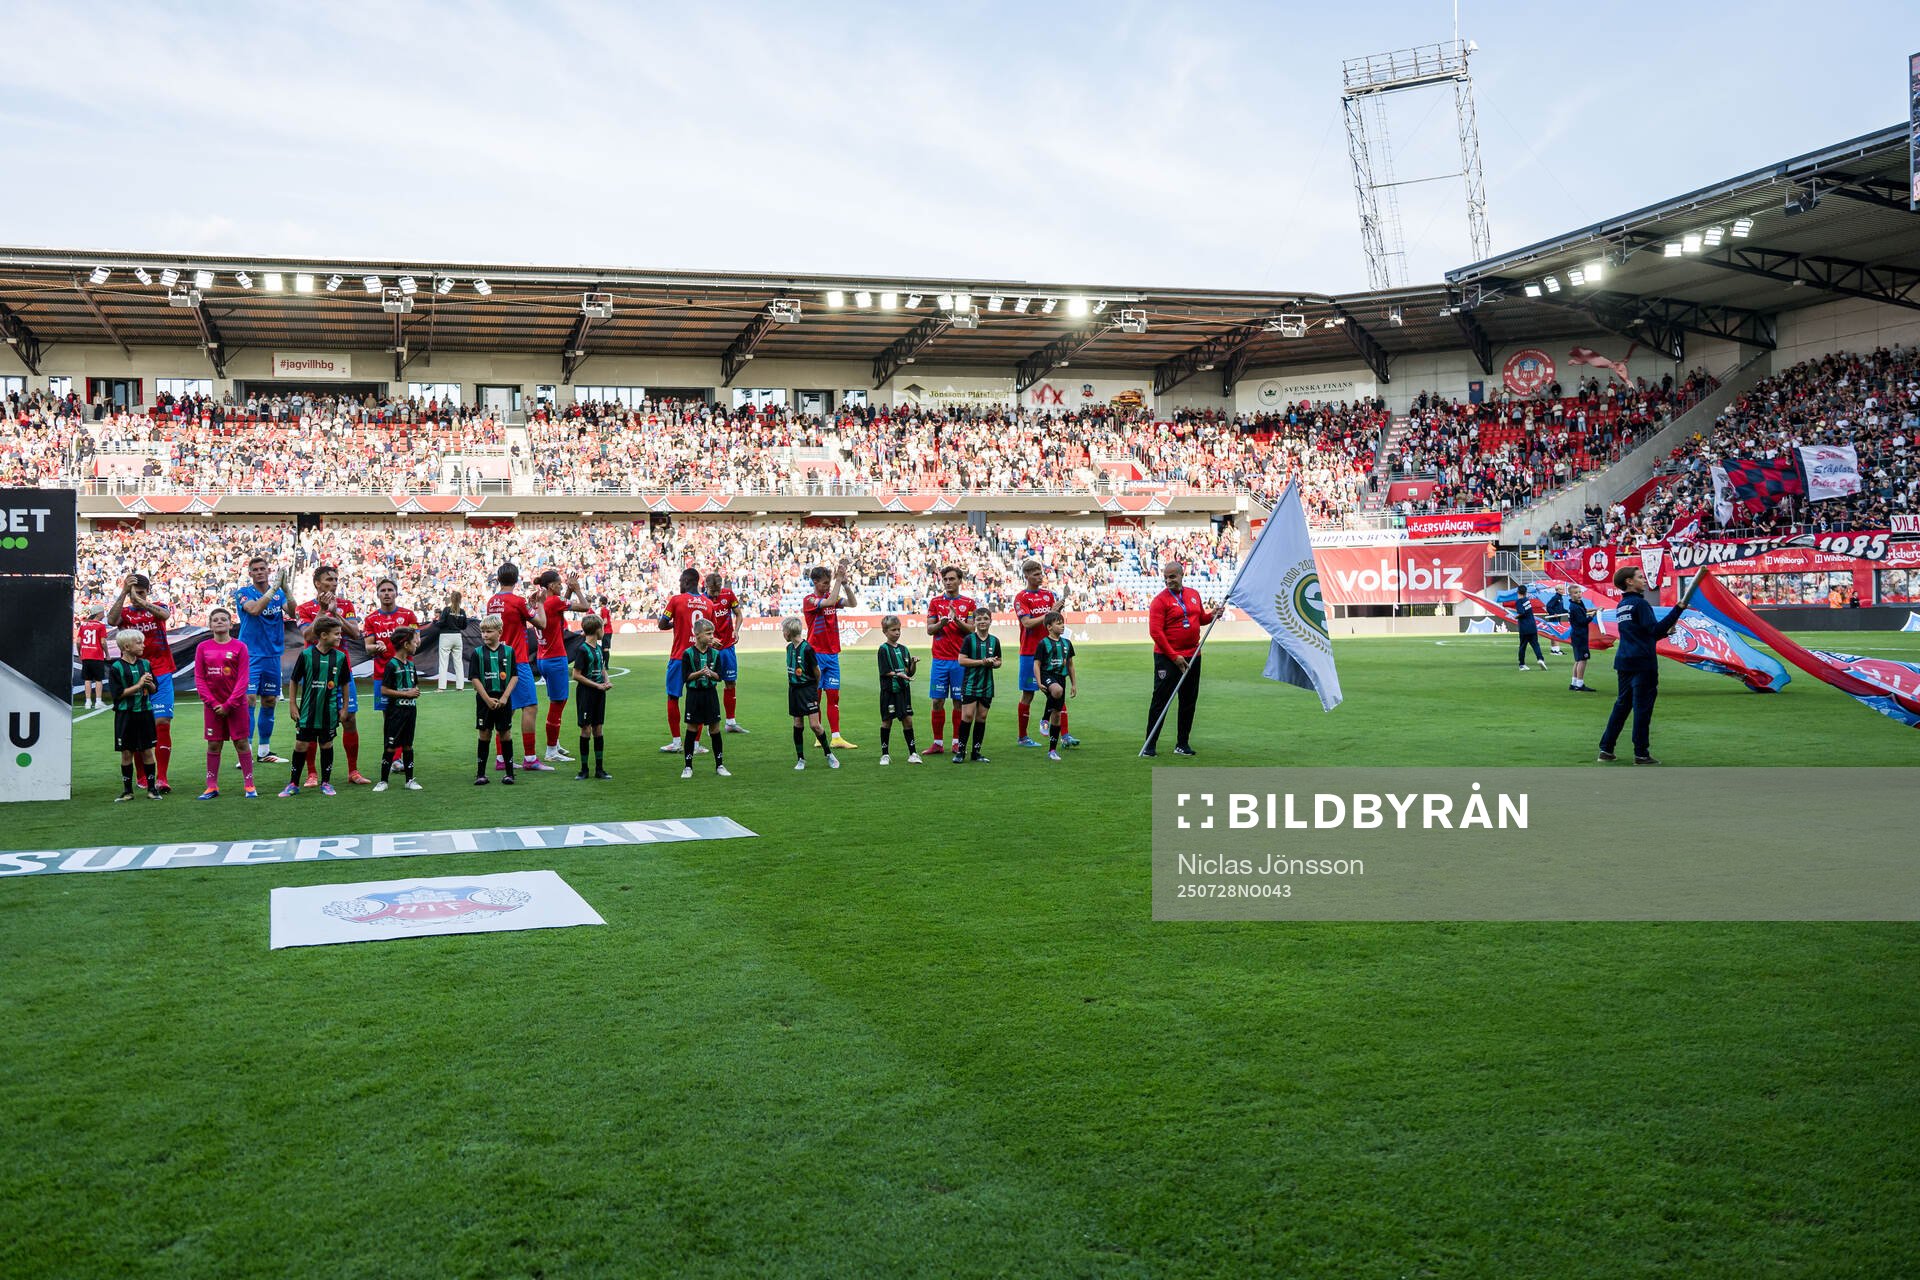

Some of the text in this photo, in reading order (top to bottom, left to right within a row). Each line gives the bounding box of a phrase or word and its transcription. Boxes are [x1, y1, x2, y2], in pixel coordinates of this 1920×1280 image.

[280, 359, 334, 371] #jagvillhbg
[1031, 383, 1064, 405] MAX
[1284, 383, 1321, 393] SVENSKA
[1323, 381, 1353, 389] FINANS
[1408, 519, 1474, 533] HÖGERSVÄNGEN
[1819, 534, 1891, 560] 1985
[1773, 556, 1804, 566] Wihlborgs
[1335, 558, 1464, 592] vobbiz
[82, 629, 97, 645] 31
[9, 711, 40, 748] U
[0, 820, 702, 876] SUPERETTAN
